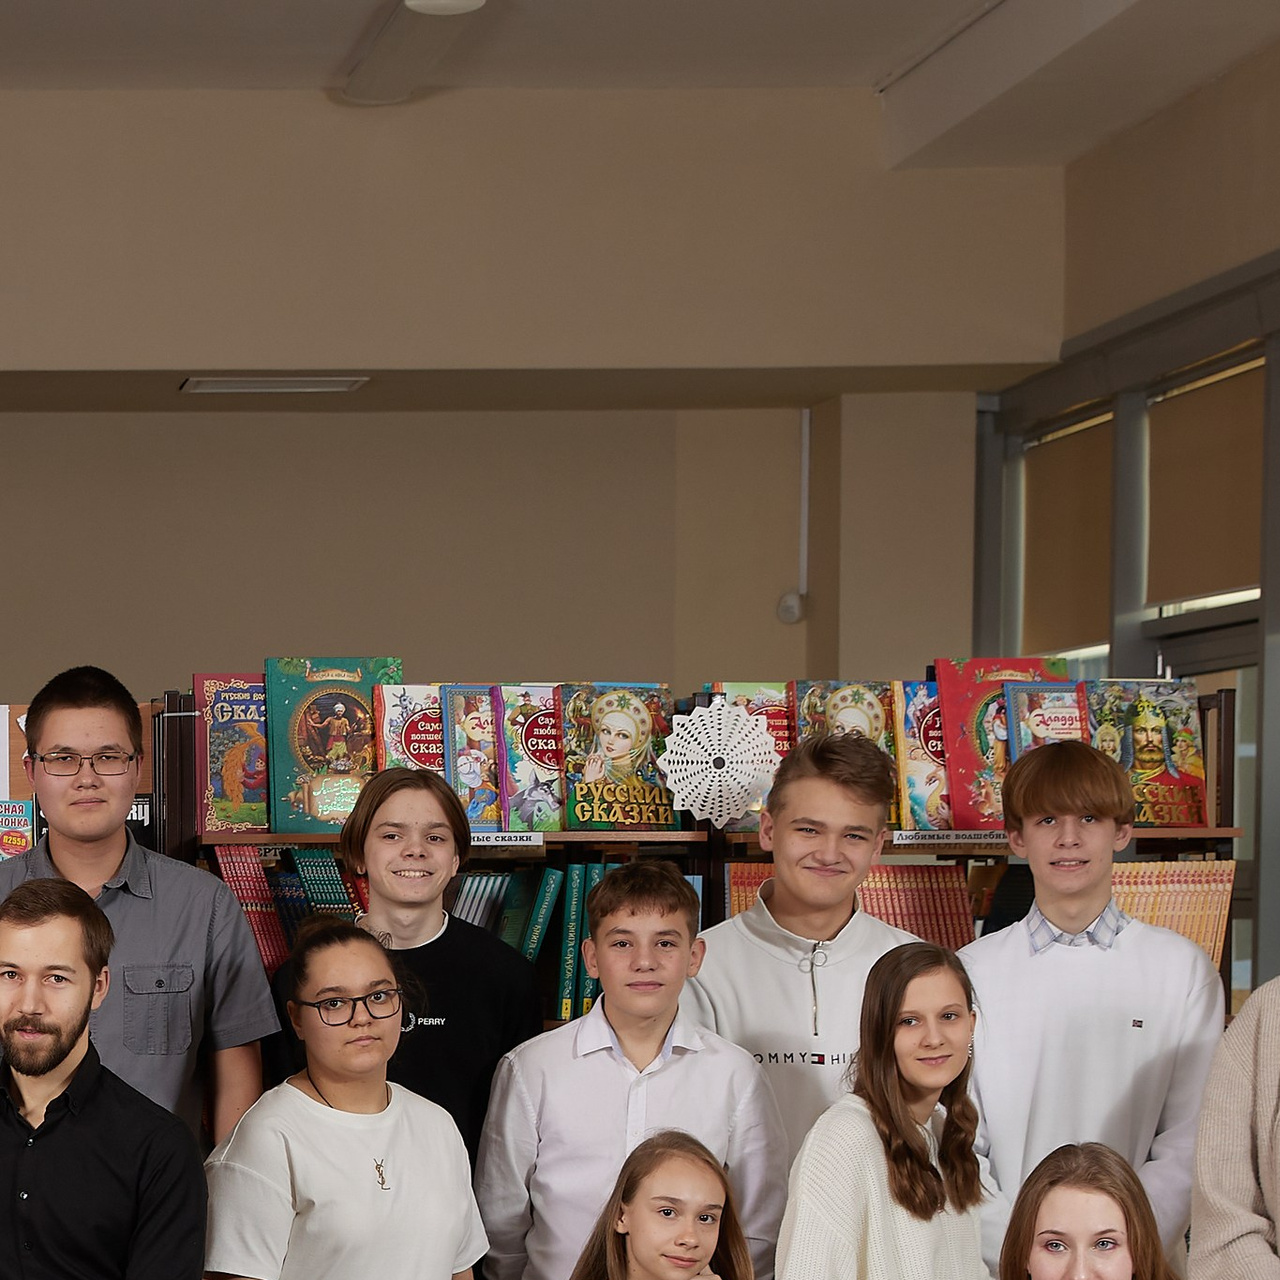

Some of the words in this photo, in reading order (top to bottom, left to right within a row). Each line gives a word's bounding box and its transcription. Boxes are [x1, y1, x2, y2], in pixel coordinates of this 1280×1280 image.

[1132, 784, 1202, 803] ССКИЕ
[574, 802, 675, 825] СКАЗКИ
[897, 832, 951, 841] Любимые
[418, 1018, 446, 1026] PERRY
